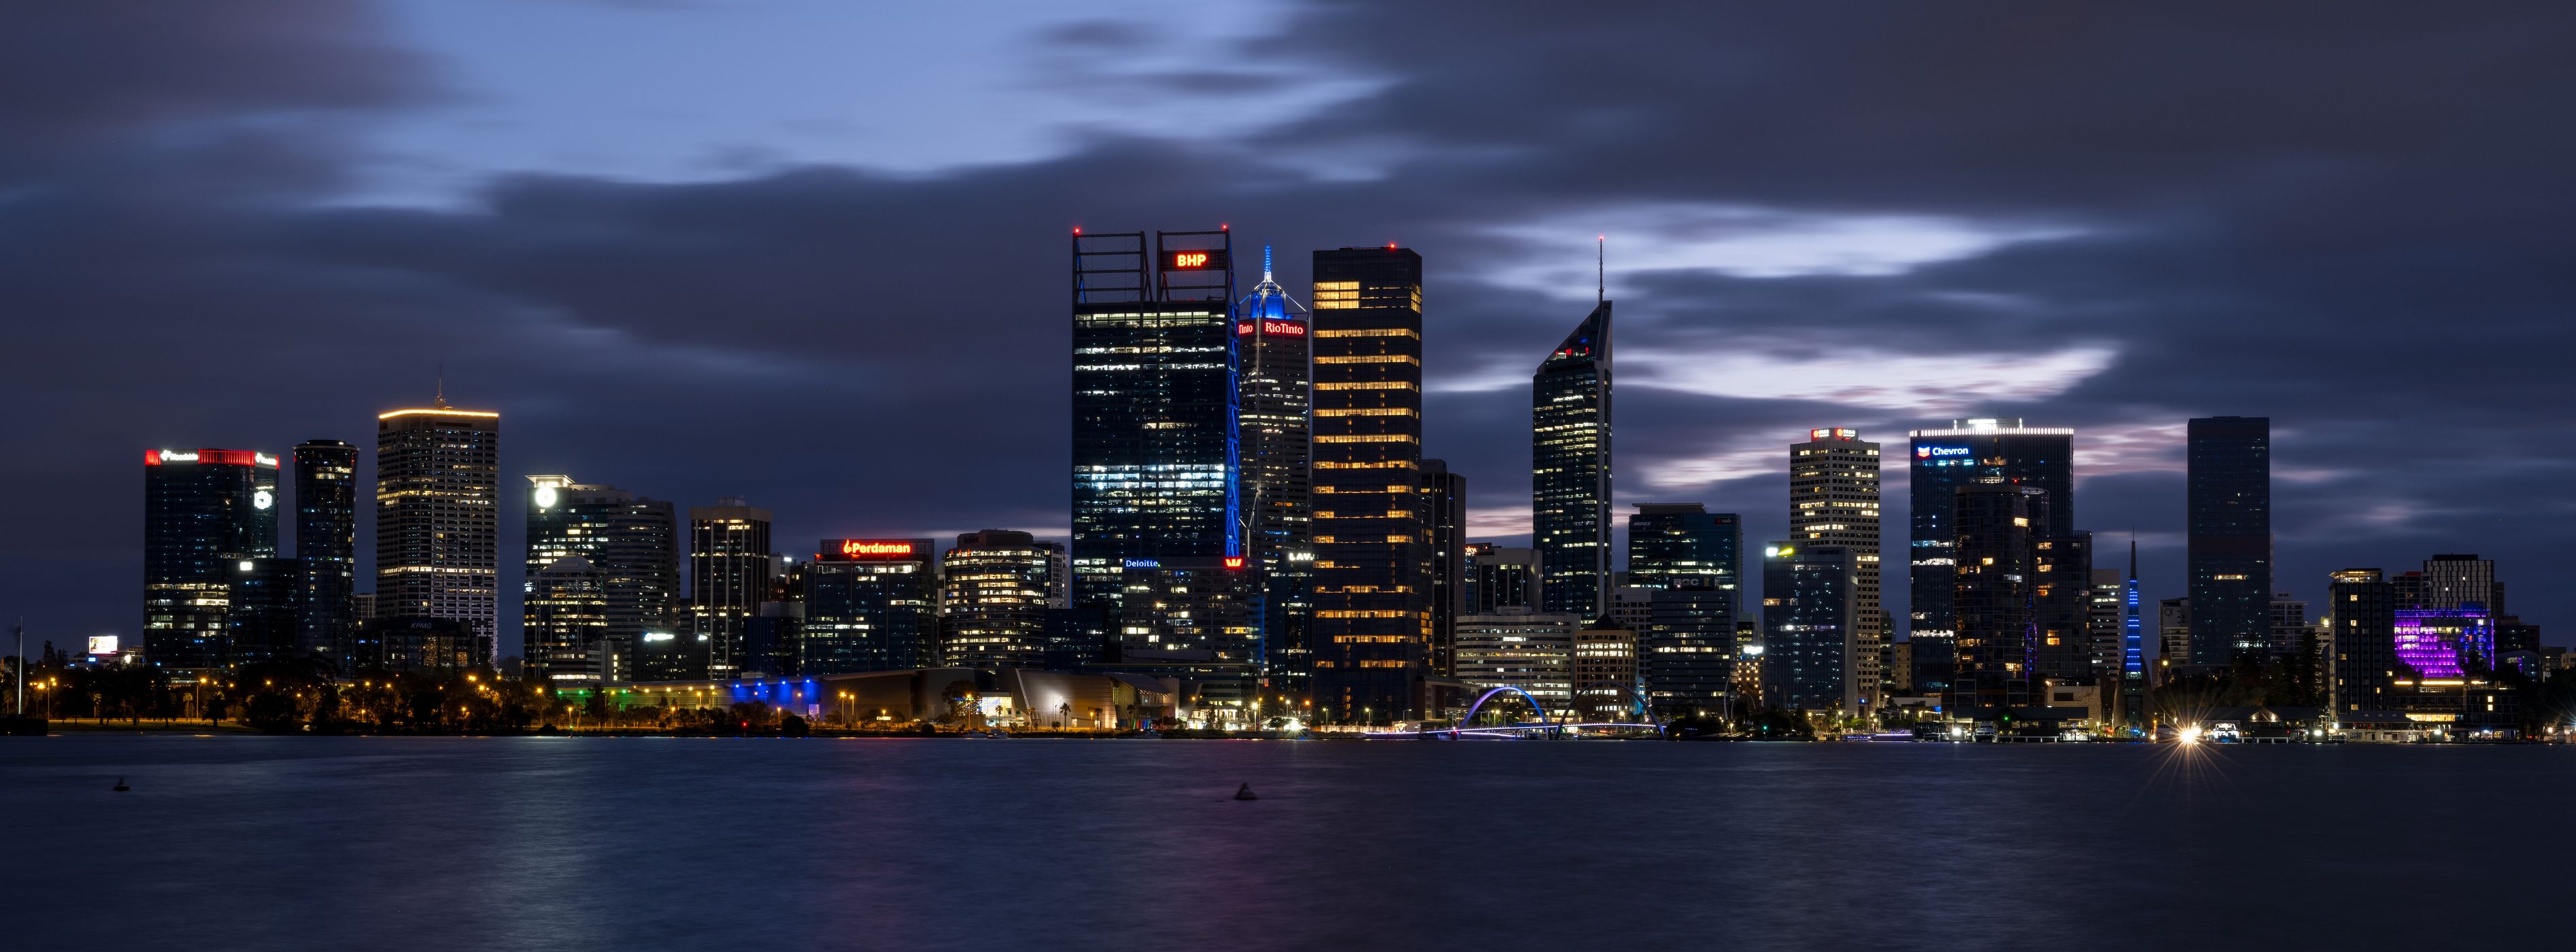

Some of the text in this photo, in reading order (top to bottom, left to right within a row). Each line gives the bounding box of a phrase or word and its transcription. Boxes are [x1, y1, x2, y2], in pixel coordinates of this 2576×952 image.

[1178, 254, 1206, 266] BHP
[1932, 447, 1969, 456] Chevron
[852, 543, 911, 554] Perdaman
